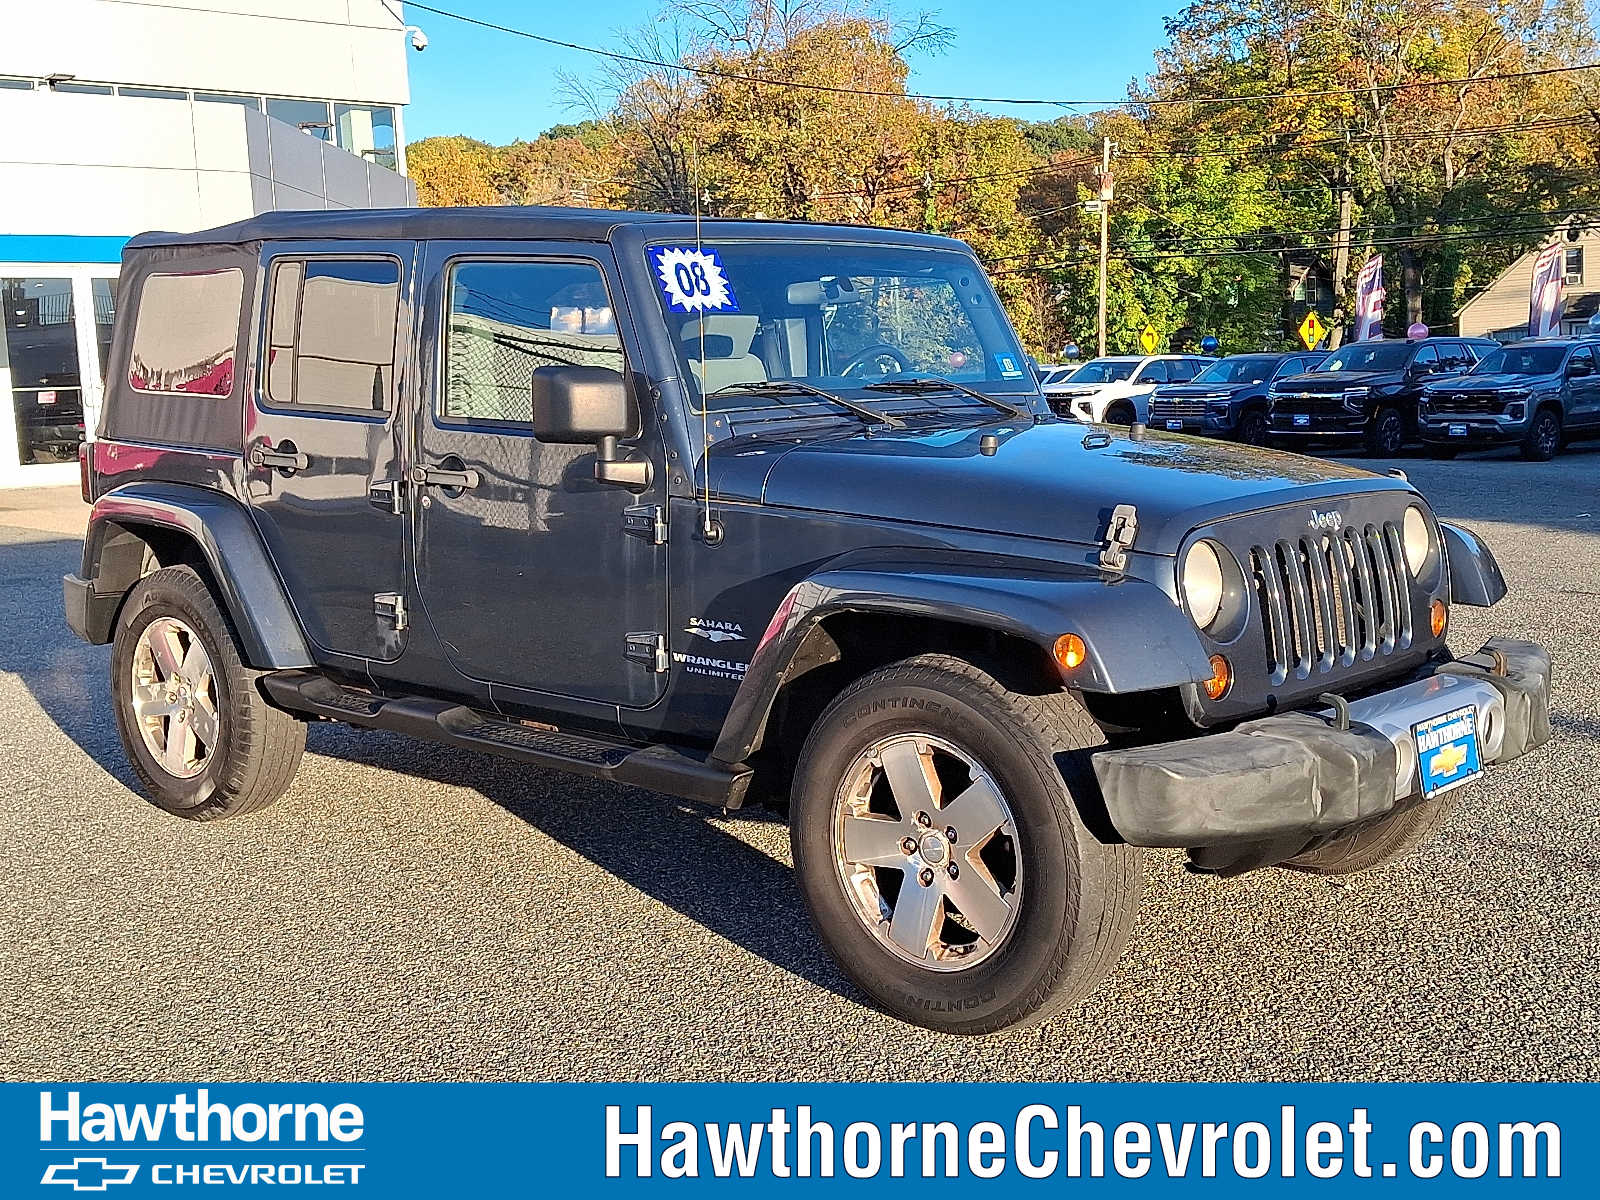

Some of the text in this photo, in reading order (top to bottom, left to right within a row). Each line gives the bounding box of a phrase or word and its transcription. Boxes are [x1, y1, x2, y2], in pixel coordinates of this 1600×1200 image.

[674, 261, 711, 297] 08
[1307, 509, 1342, 531] Jeep
[689, 617, 742, 632] SAHARA
[686, 666, 745, 681] UNLIMITED
[1416, 718, 1473, 754] HAWTHORNE
